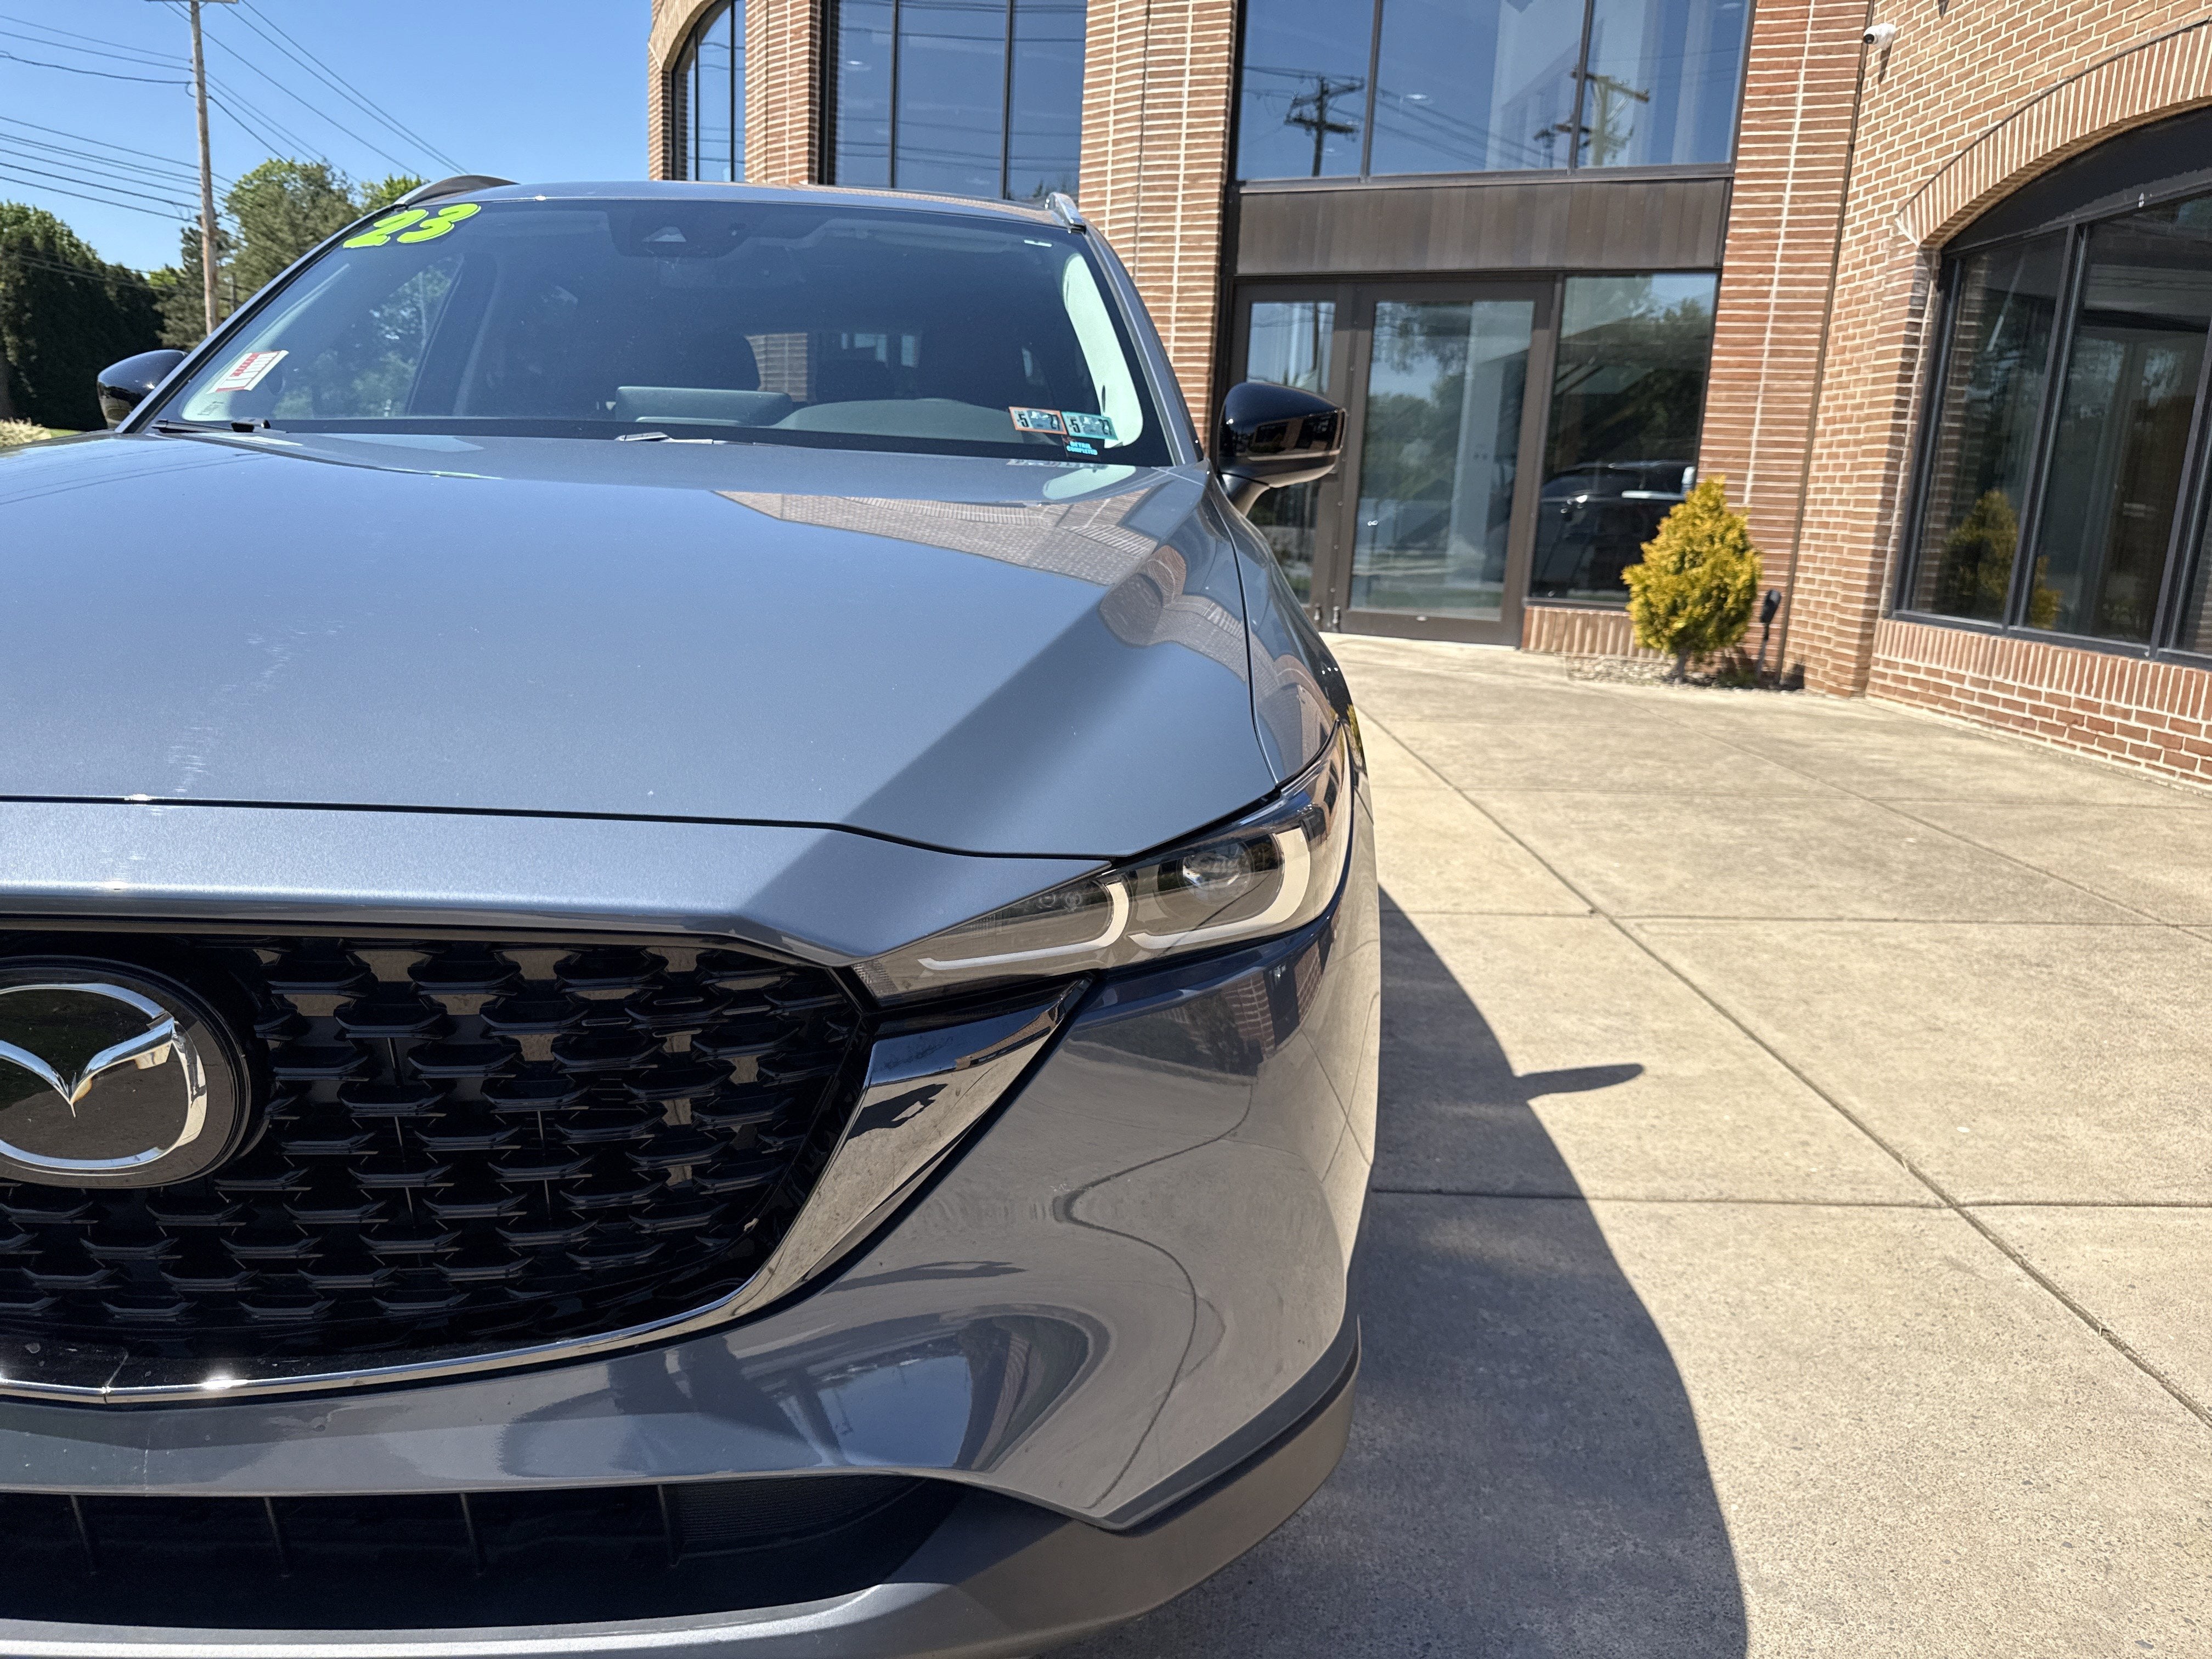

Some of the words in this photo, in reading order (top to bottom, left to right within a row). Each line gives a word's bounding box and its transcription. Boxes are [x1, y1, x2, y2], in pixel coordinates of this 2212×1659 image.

[342, 204, 481, 249] 23
[1018, 414, 1029, 427] 5
[1070, 419, 1080, 433] 5
